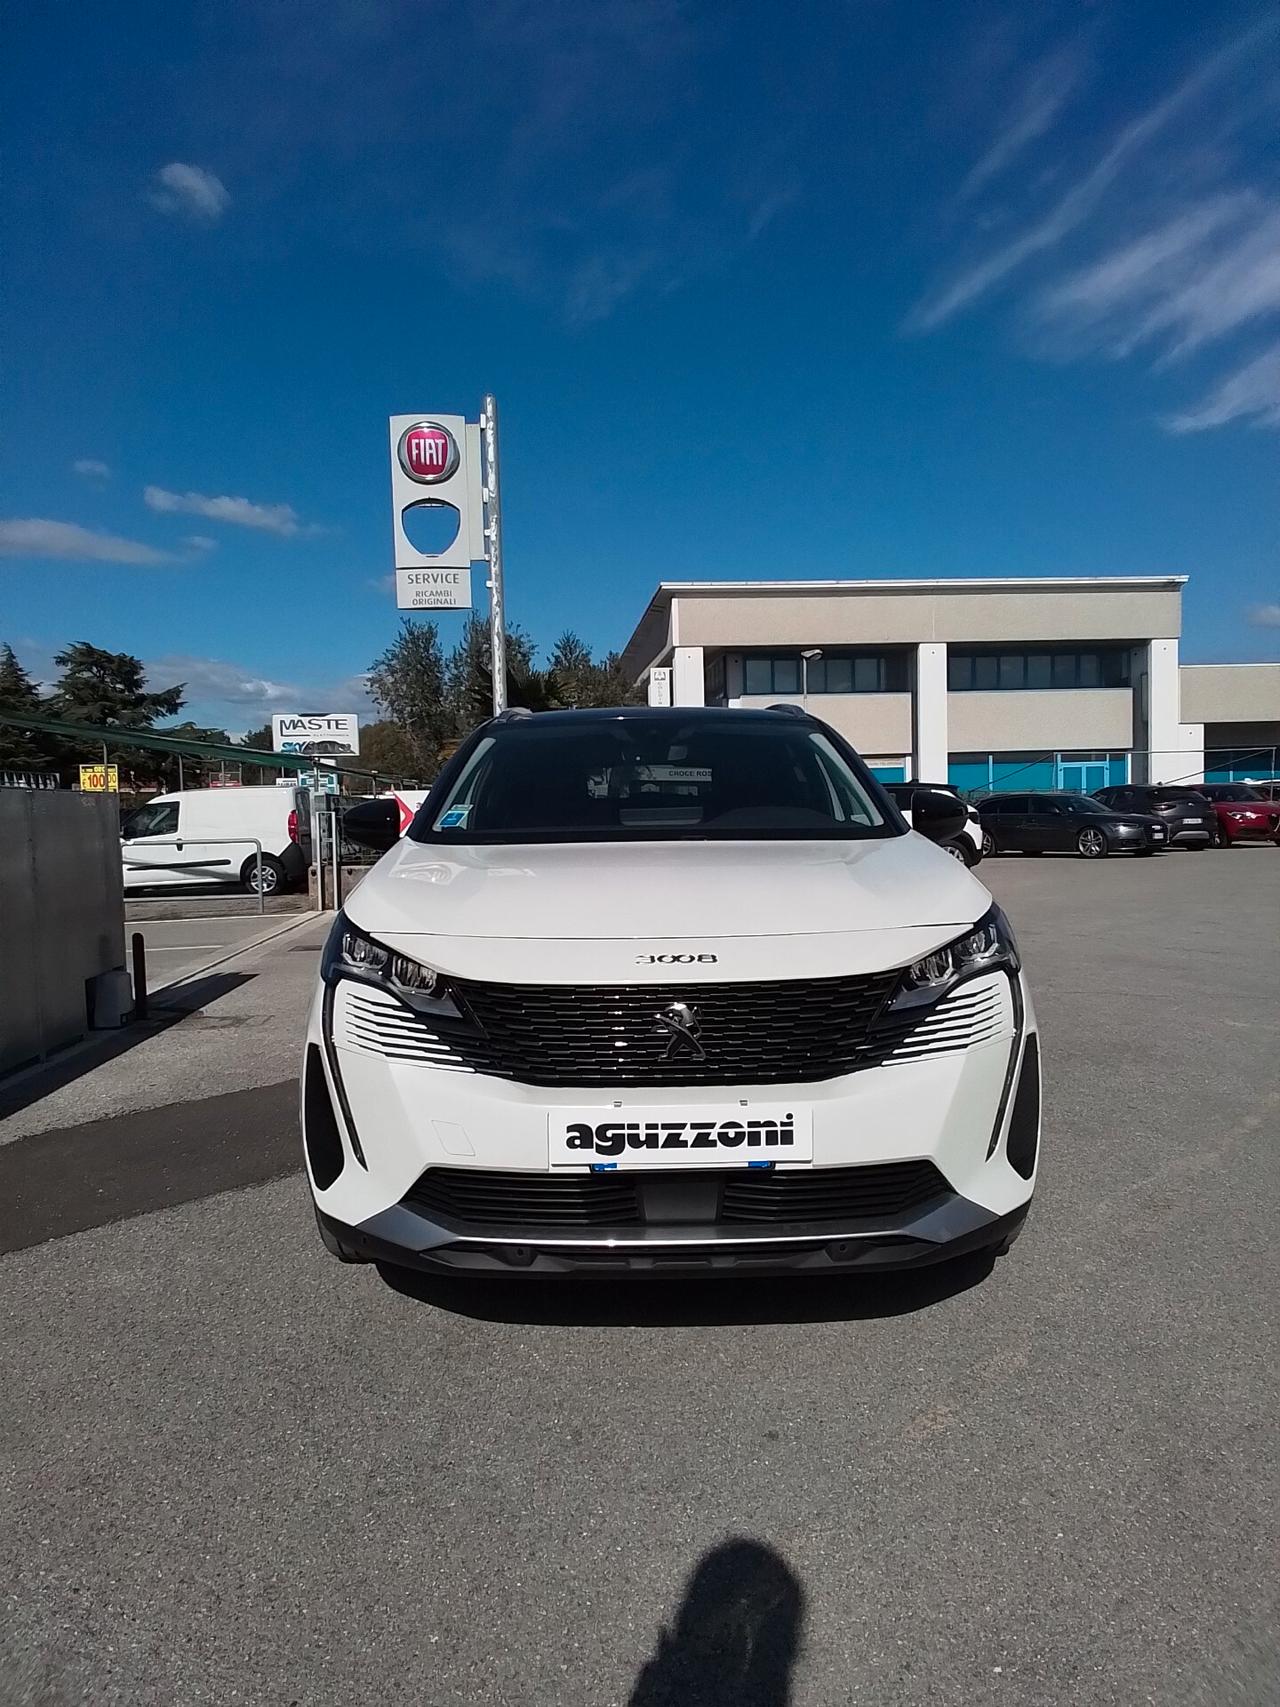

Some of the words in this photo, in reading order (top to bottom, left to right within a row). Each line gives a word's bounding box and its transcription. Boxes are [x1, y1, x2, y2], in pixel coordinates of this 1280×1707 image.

[411, 438, 445, 465] FIAT
[407, 572, 460, 585] SERVICE
[415, 590, 452, 598] RICAMBI
[412, 597, 456, 606] ORIGINALI
[279, 718, 348, 731] MASTE
[634, 954, 718, 964] 3008
[566, 1112, 794, 1156] aguzzoni
